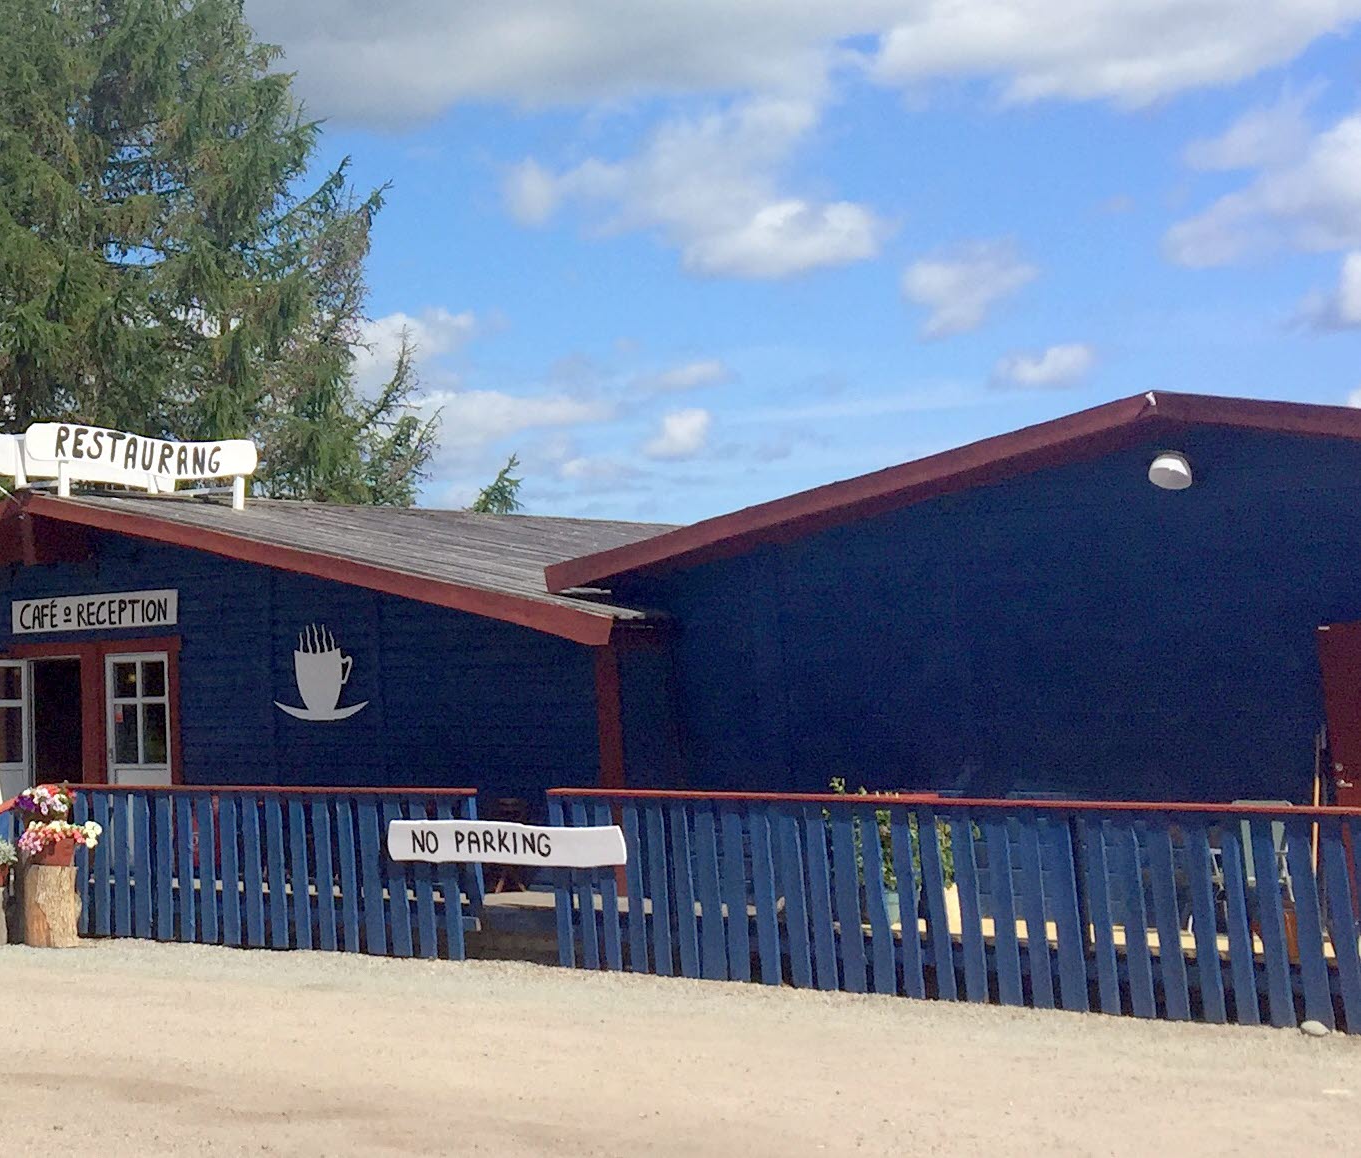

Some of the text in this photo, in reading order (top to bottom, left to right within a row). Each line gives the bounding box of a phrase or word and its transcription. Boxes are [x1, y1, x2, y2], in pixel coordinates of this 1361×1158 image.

[55, 426, 221, 475] RESTAURANG
[19, 600, 58, 630] CAFÉ
[77, 598, 168, 627] RECEPTION
[411, 829, 551, 857] NO PARKING
